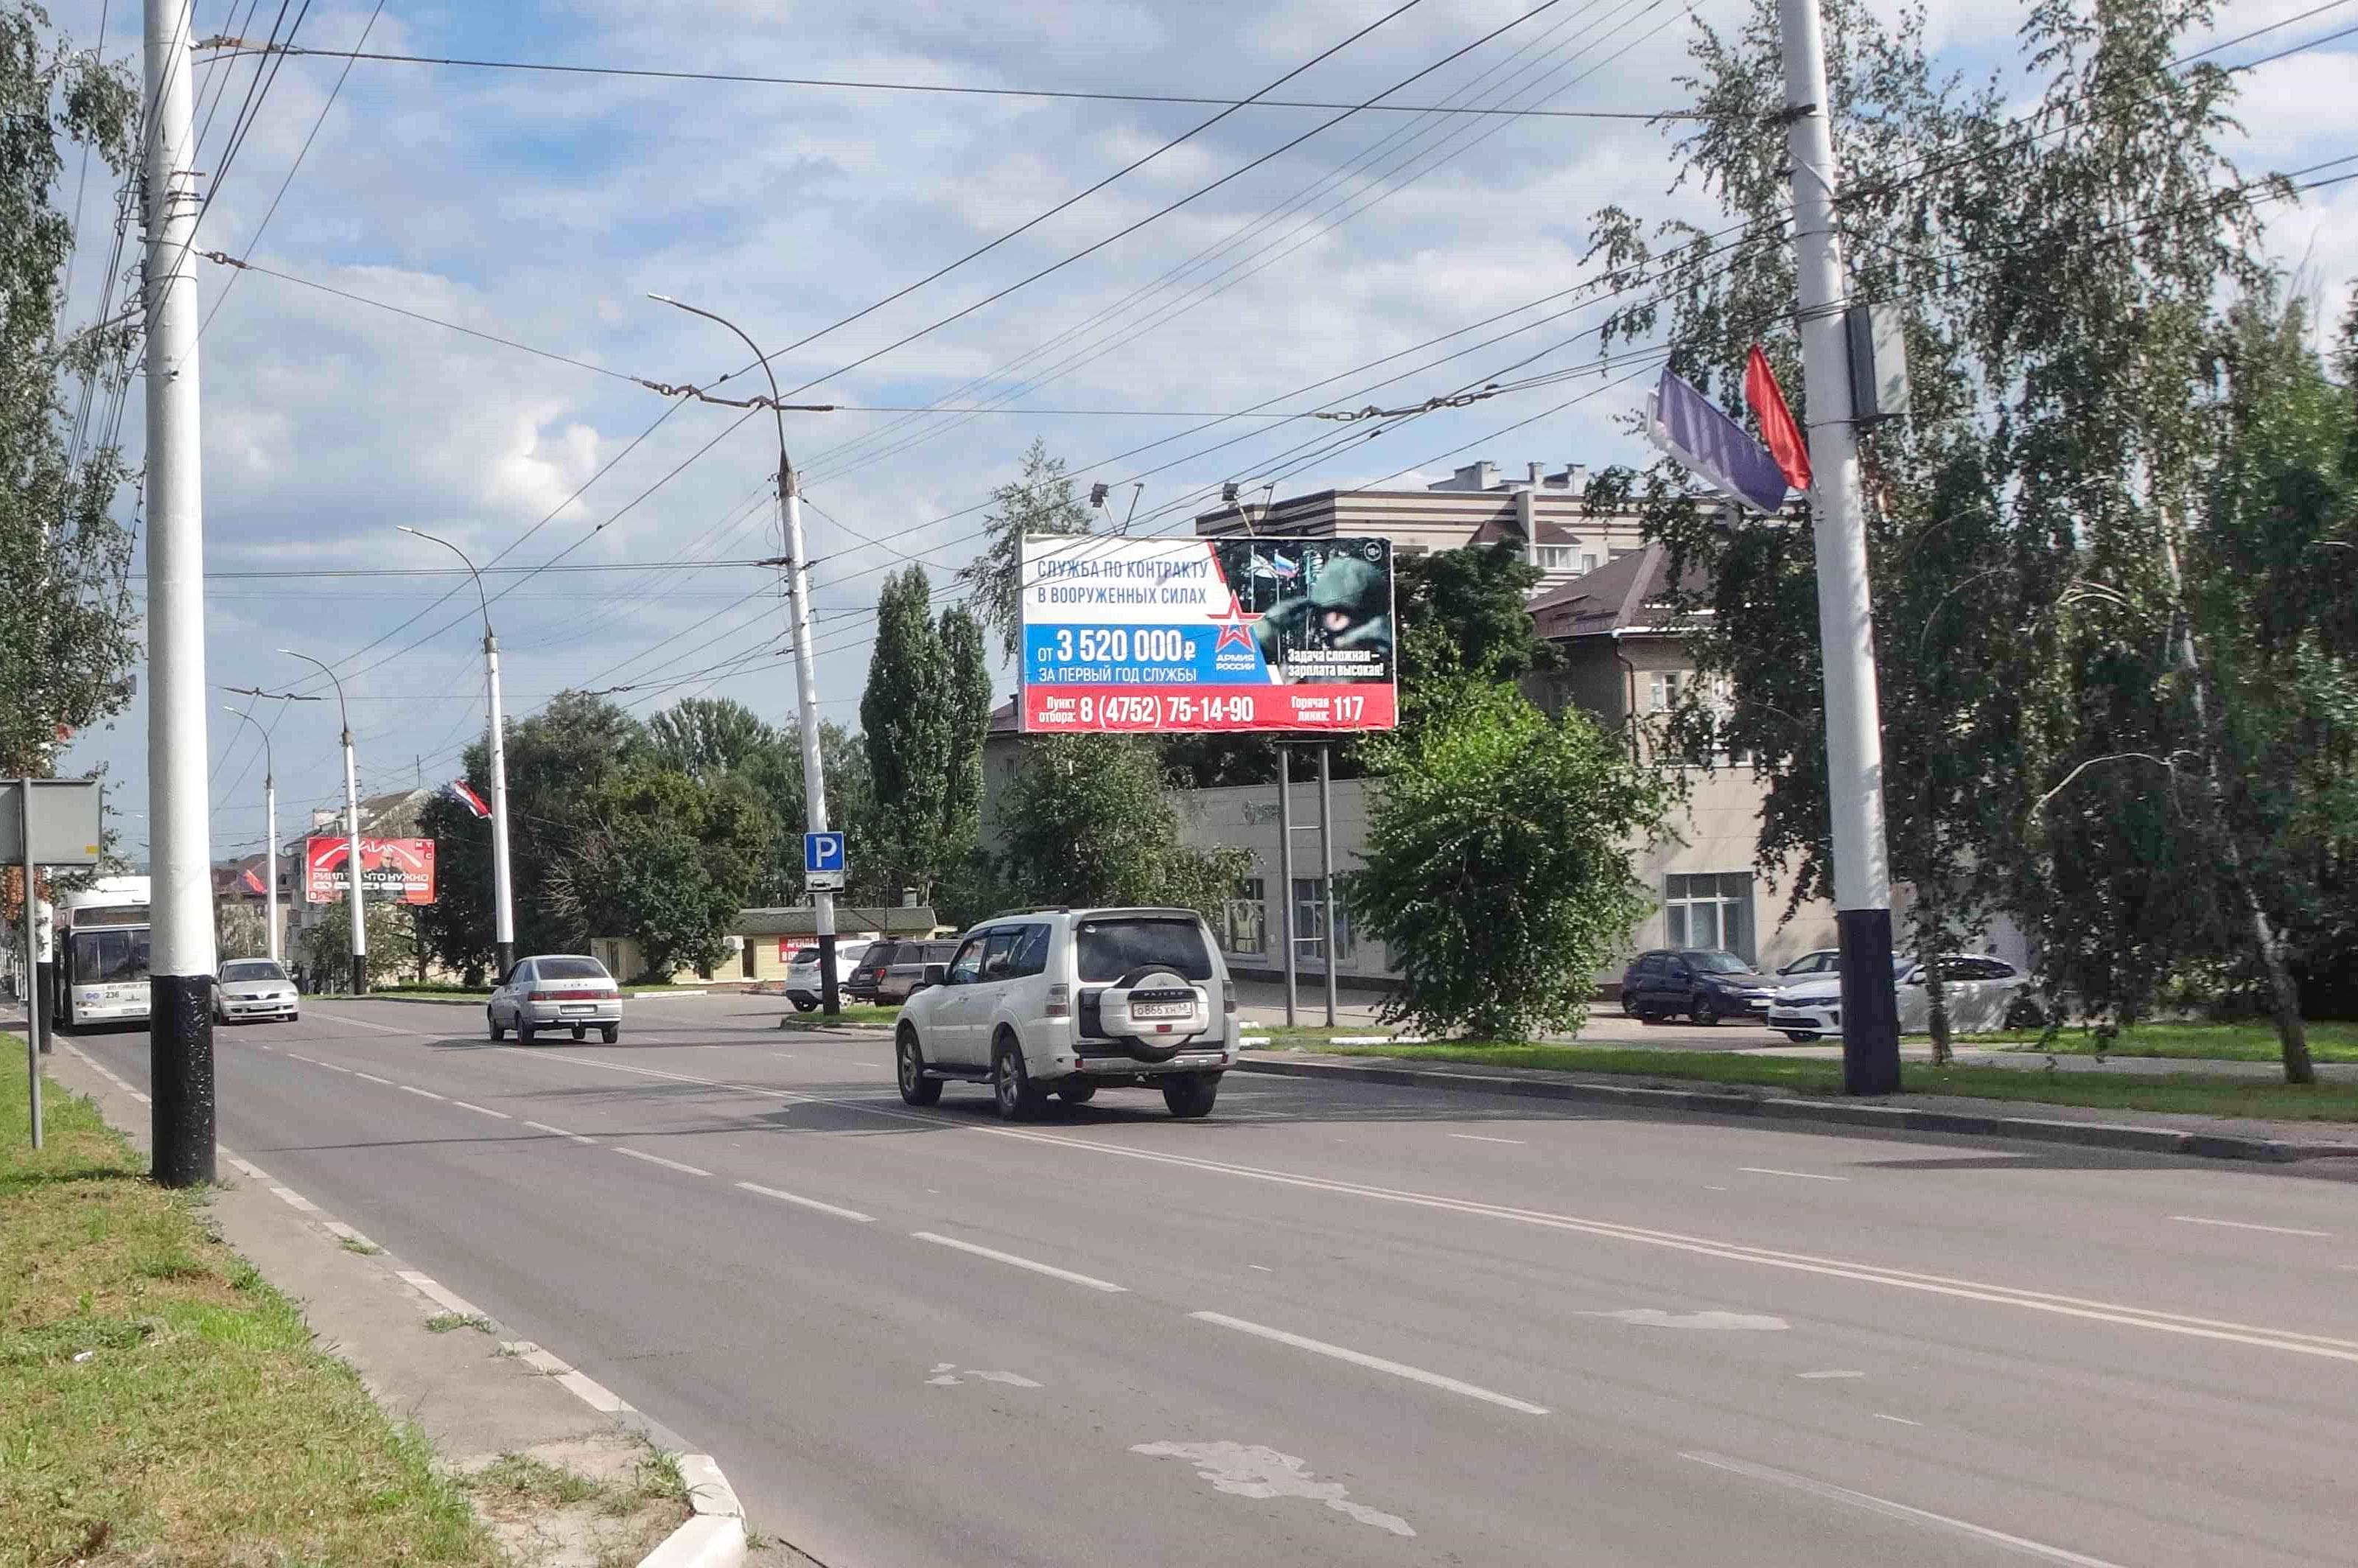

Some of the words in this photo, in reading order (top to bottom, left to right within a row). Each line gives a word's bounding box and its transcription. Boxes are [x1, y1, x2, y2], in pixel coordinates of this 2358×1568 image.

[1037, 560, 1099, 578] СЛУЖБА
[1105, 561, 1122, 578] ПО
[1127, 561, 1208, 579] КОНТРАКТУ
[1038, 587, 1046, 603] В
[1051, 587, 1157, 604] ВООРУЖЕННЫХ
[1161, 588, 1207, 604] СИЛАХ
[1057, 629, 1073, 662] 3
[1080, 629, 1128, 662] 520
[1216, 654, 1255, 662] АРМИЯ
[1287, 648, 1326, 663] Задача
[1326, 650, 1371, 662] сложная
[1038, 668, 1055, 682] ЗА
[1059, 665, 1111, 682] ПЕРВЫЙ
[1116, 668, 1140, 684] ГОД
[1143, 668, 1197, 682] СЛУЖБЫ
[1288, 664, 1337, 679] зарплата
[1337, 663, 1384, 676] высокая!
[1046, 696, 1076, 713] Пункт
[1080, 697, 1094, 722] 8
[1099, 696, 1162, 728] (4752)
[1166, 696, 1254, 722] 75-14-90
[1291, 696, 1329, 711] Горячая
[1334, 696, 1364, 721] 117
[1039, 710, 1076, 724] отбора:
[816, 837, 837, 867] P
[388, 872, 429, 882] НУЖНО
